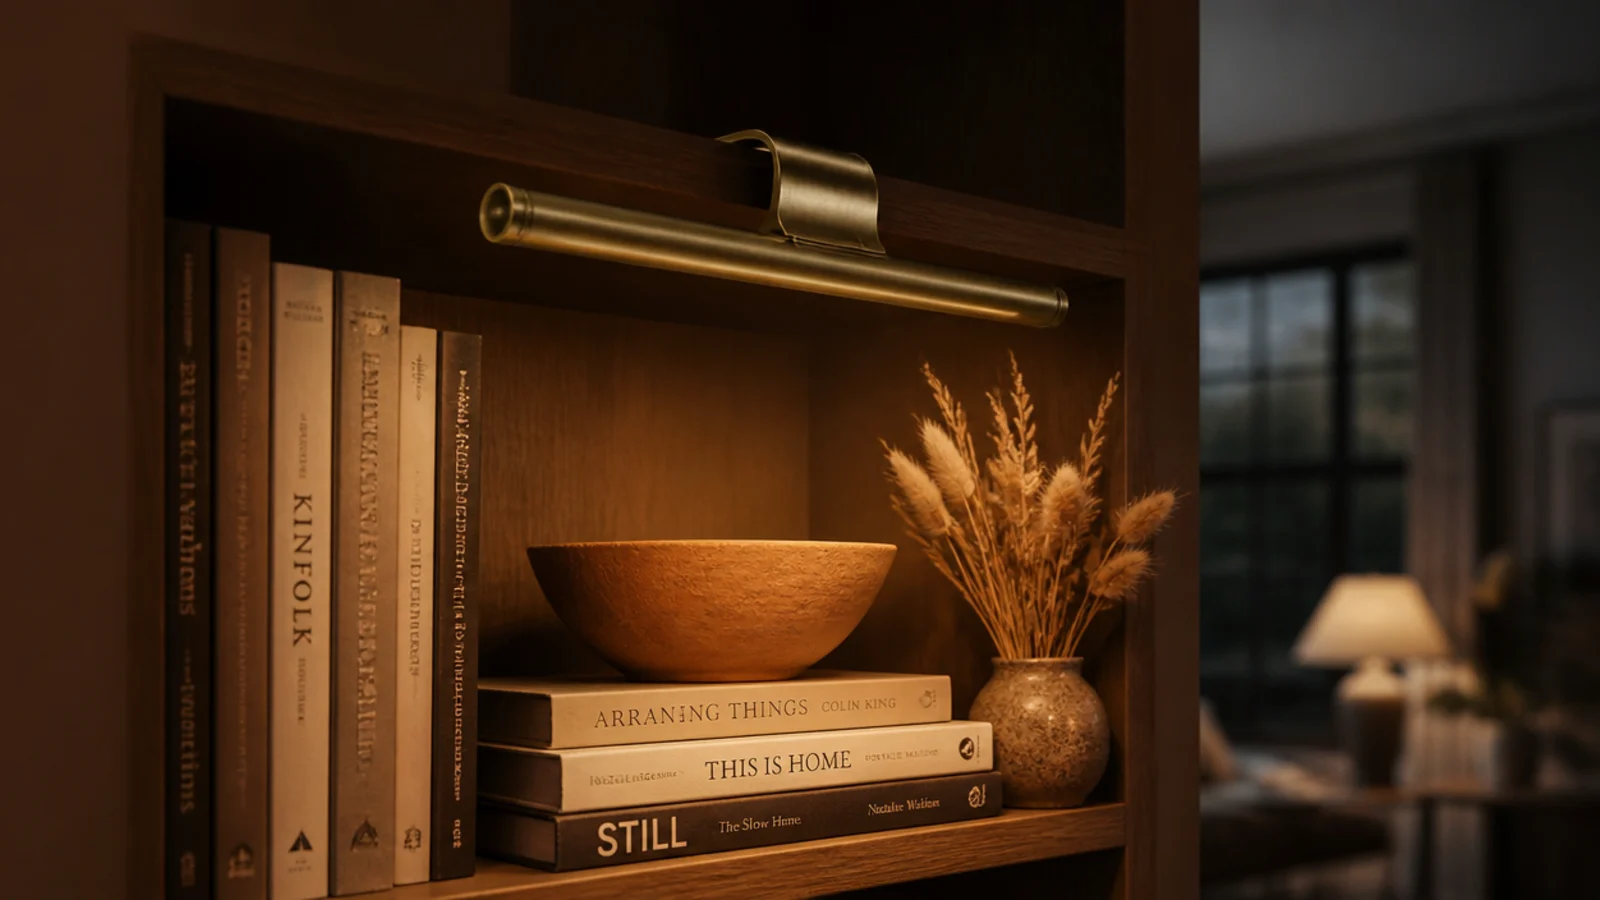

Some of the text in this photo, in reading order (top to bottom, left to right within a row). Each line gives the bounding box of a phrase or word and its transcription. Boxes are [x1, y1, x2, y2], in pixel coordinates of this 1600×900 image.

[293, 493, 313, 647] KINFOLK
[728, 698, 808, 719] THINGS
[821, 697, 897, 713] COLIN KING
[704, 757, 758, 780] THIS
[764, 755, 783, 776] IS
[788, 750, 852, 774] HOME
[597, 816, 687, 857] STILL
[718, 820, 740, 834] The
